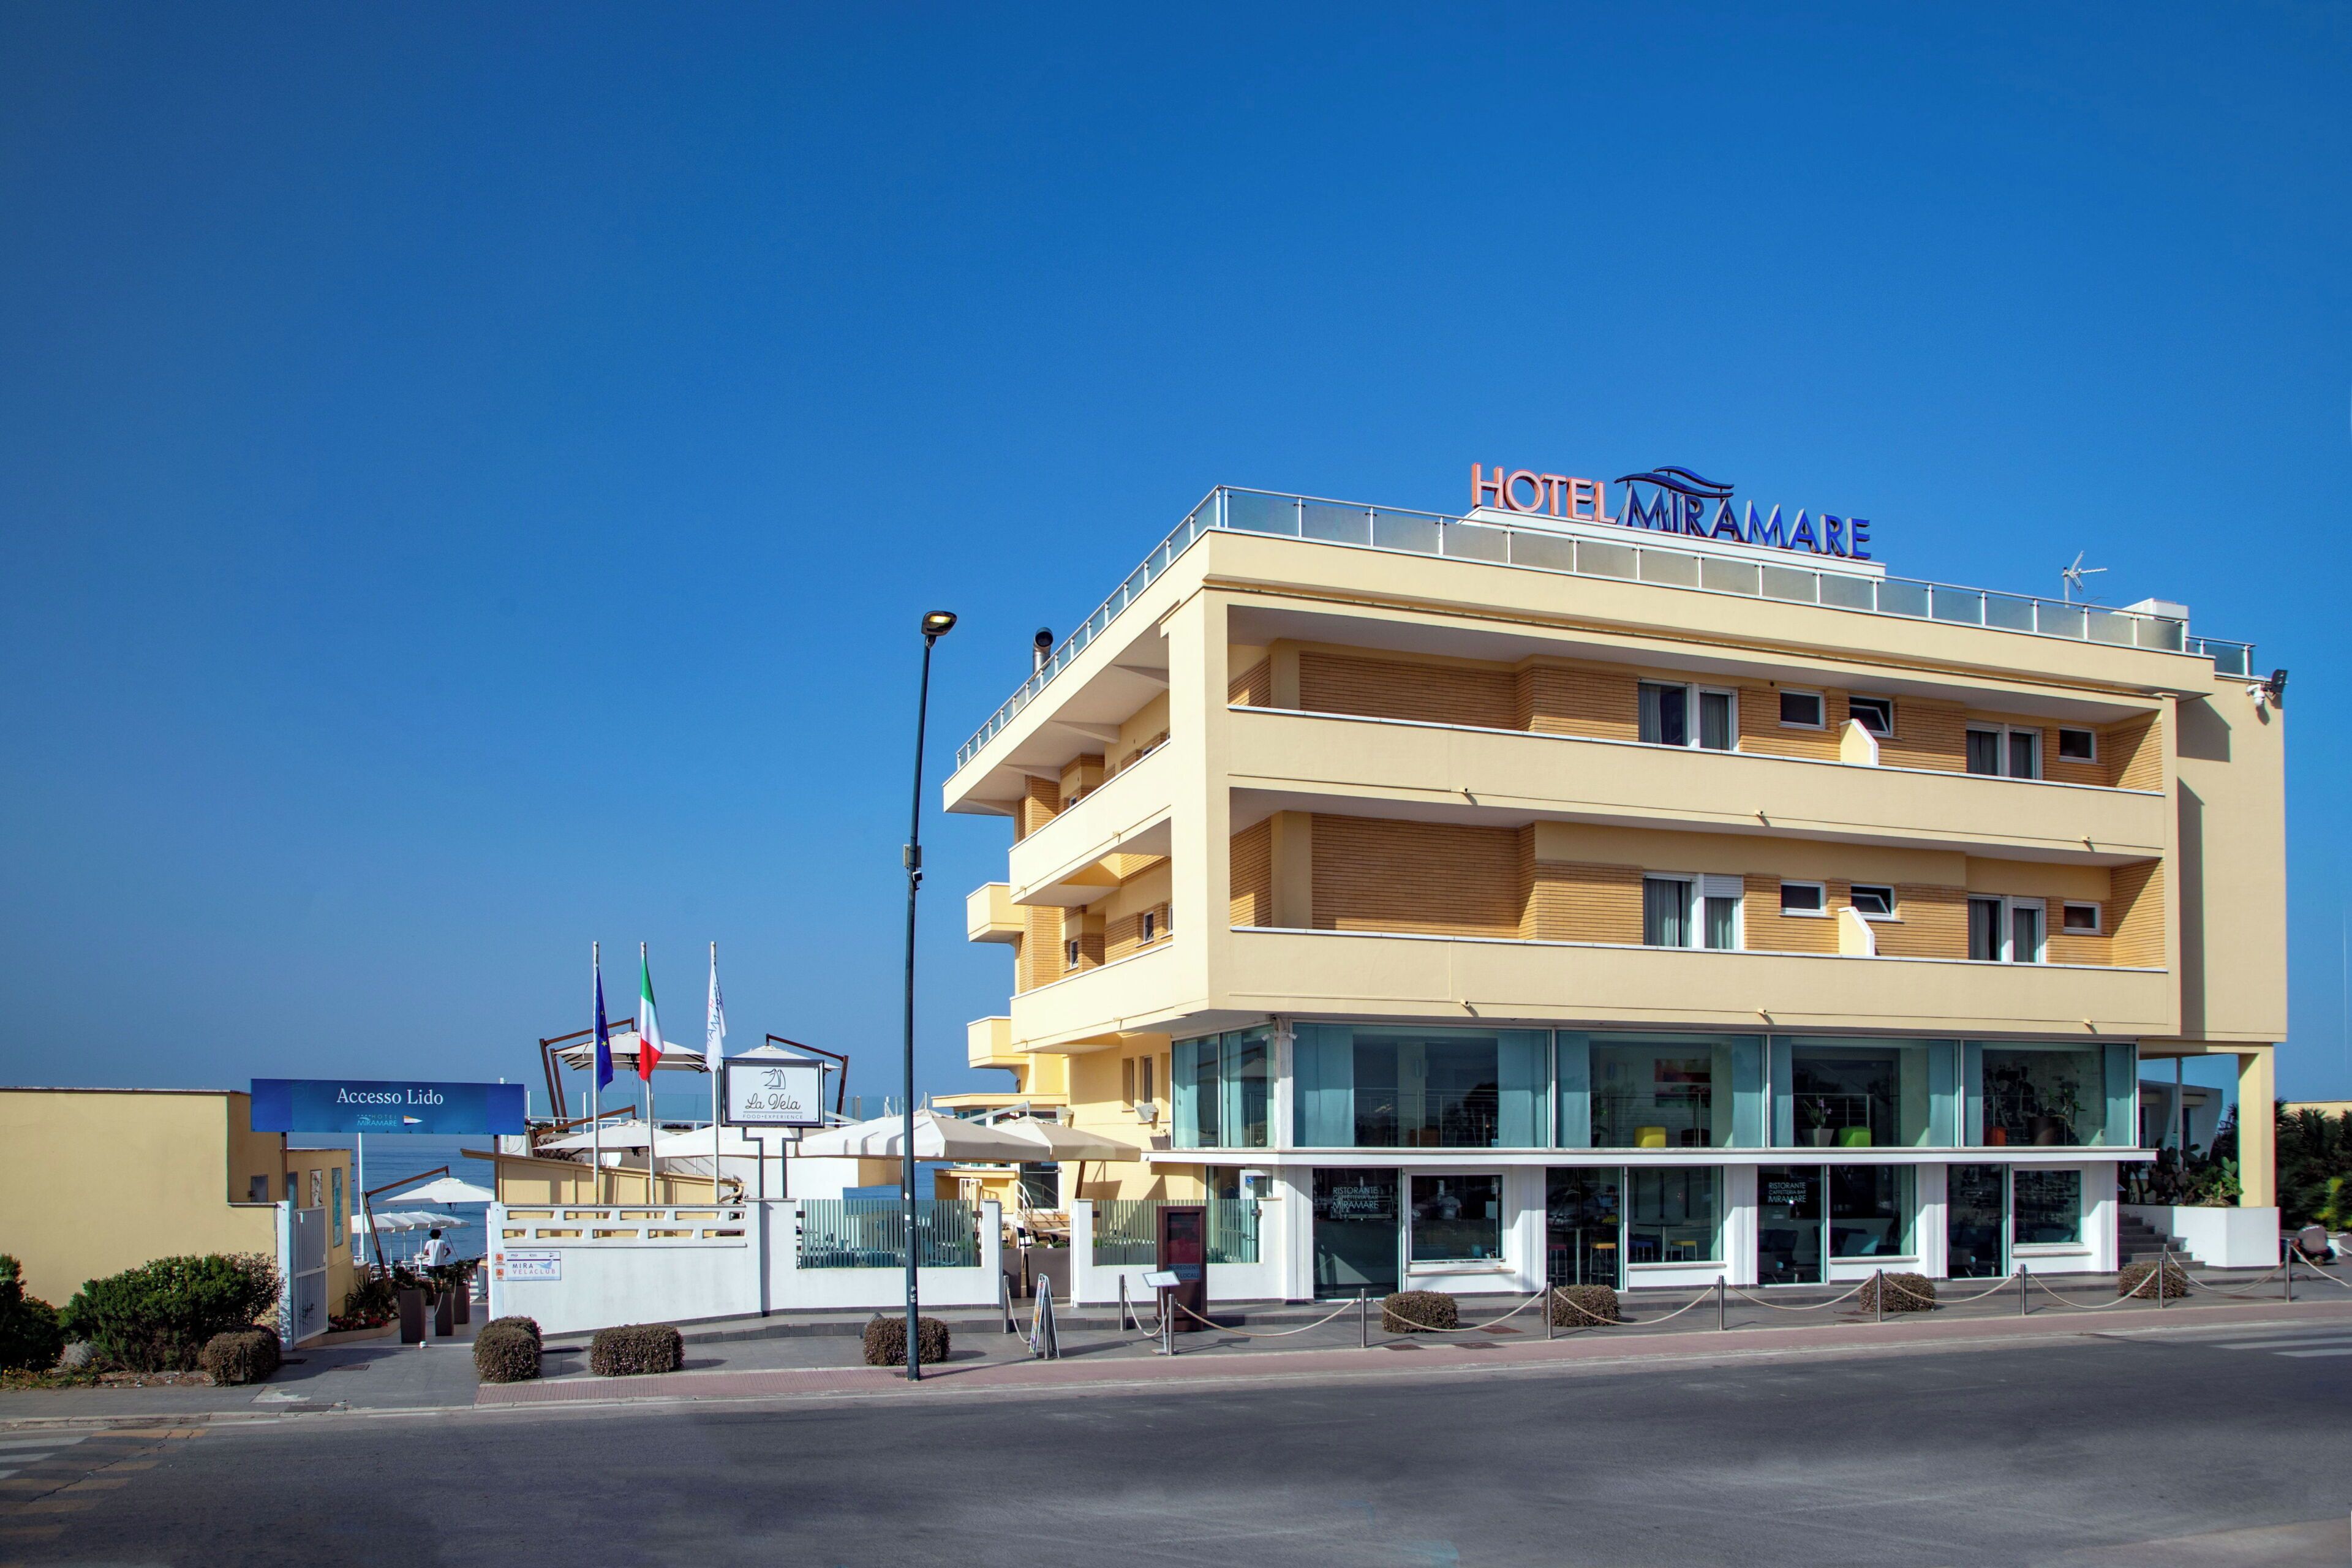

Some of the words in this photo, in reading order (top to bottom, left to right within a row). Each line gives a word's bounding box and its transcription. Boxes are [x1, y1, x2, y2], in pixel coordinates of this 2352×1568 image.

[1472, 462, 1619, 525] HOTEL
[1615, 484, 1871, 560] MIRAMARE
[336, 1088, 402, 1104] Accesso
[407, 1089, 443, 1105] Lido
[745, 1093, 764, 1109] La
[768, 1093, 801, 1110] Vela
[1332, 1200, 1379, 1209] MIRAMARE
